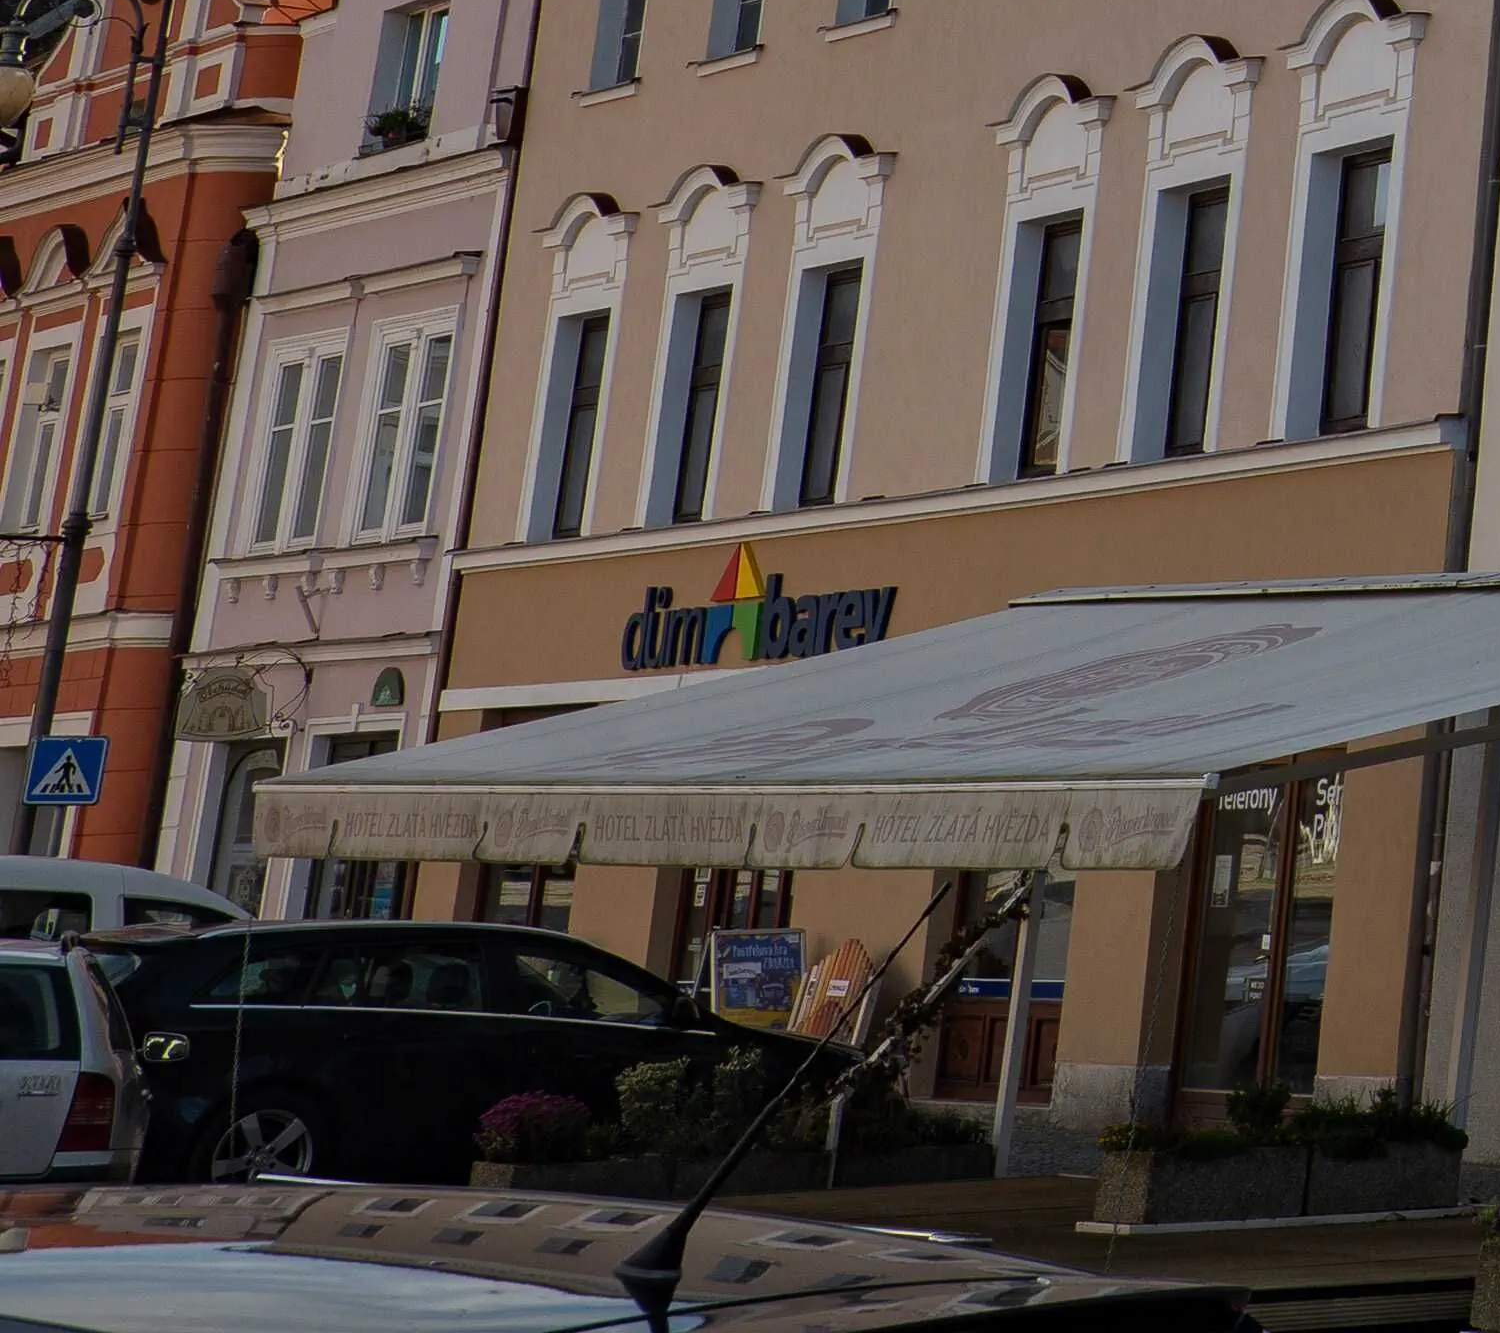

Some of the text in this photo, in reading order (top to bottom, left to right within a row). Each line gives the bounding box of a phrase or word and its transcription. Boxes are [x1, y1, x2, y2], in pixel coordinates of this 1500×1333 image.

[621, 586, 708, 671] dům
[344, 812, 384, 838] HOTEL
[593, 815, 640, 842] HOTEL
[872, 809, 1049, 844] HOTEL ZLATÁ HVĚZDA
